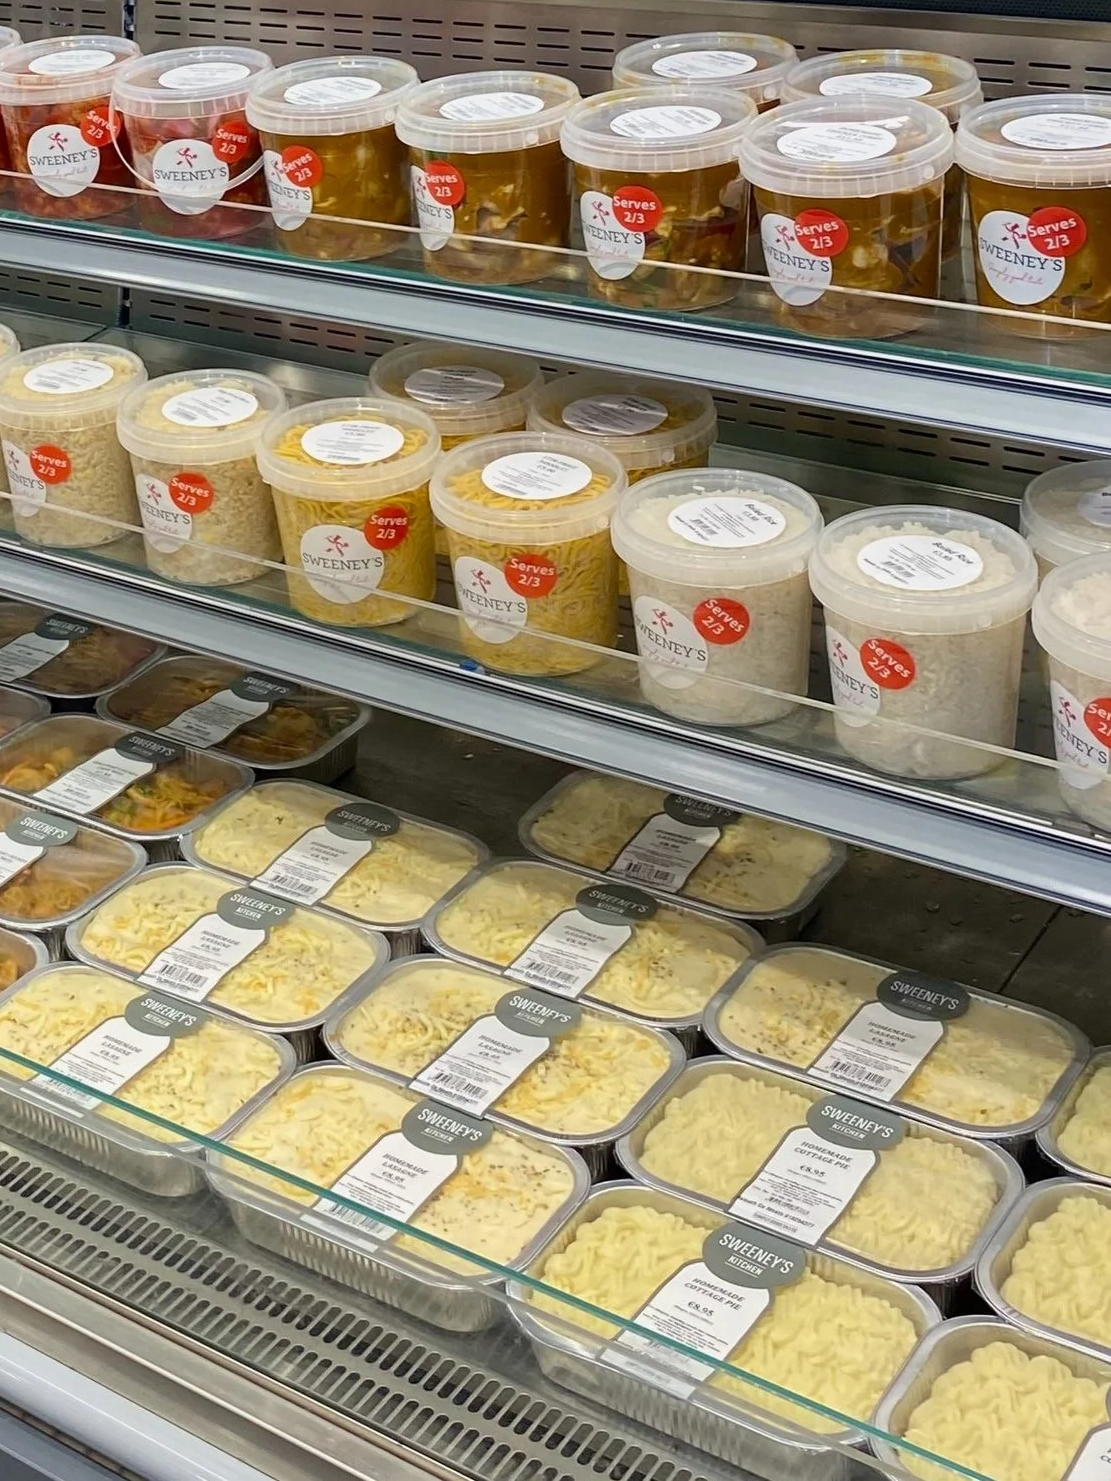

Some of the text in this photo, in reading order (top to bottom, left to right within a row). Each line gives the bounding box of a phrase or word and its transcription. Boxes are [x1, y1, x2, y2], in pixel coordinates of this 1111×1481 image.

[86, 110, 116, 133] Serves
[89, 127, 103, 139] 2/3
[215, 129, 248, 144] Serves
[29, 146, 98, 167] SWEENEY'S
[220, 142, 237, 155] 2/3
[283, 153, 313, 173] Serves
[154, 166, 227, 182] SWEENEY'S
[294, 168, 312, 181] 2/3
[426, 172, 458, 184] Serves
[435, 185, 452, 198] 2/3
[613, 195, 657, 211] Serves
[623, 210, 645, 223] 2/3
[795, 221, 840, 236] Serves
[1027, 216, 1077, 238] Serves
[809, 236, 833, 249] 2/3
[1044, 234, 1070, 250] 2/3
[980, 237, 1063, 272] SWEENEY'S
[31, 449, 67, 468] Serves
[38, 464, 56, 477] 2/3
[170, 477, 210, 498] Serves
[176, 492, 196, 507] 2/3
[369, 514, 408, 527] Serves
[376, 529, 396, 540] 2/3
[302, 552, 383, 570] SWEENEY'S
[509, 558, 556, 577] Serves
[517, 574, 541, 588] 2/3
[701, 616, 725, 636] 2/3
[705, 599, 745, 633] Serves
[866, 639, 912, 678] Serves
[866, 657, 891, 679] 2/3
[1087, 702, 1111, 724] Ser
[20, 816, 68, 839] SWEENEY'S
[338, 810, 392, 832] SWEENEY'S
[230, 893, 286, 916] SWEENEY'S
[589, 888, 649, 914] SWEENEY'S
[890, 980, 960, 1011] SWEENEY'S
[141, 998, 197, 1027] SWEENEY'S
[509, 995, 572, 1023] SWEENEY'S
[418, 1108, 483, 1142] SWEENEY'S
[821, 1105, 894, 1139] SWEENEY'S
[831, 1122, 866, 1140] KITCHEN
[793, 1147, 851, 1170] COTTAGE PIE
[801, 1140, 853, 1164] HOMEMADE
[719, 1233, 794, 1275] SWEENEY'S
[728, 1254, 763, 1276] KITCHEN
[684, 1282, 743, 1311] COTTAGE PIE
[692, 1278, 746, 1303] HOMEMADE
[687, 1300, 715, 1318] €8.95
